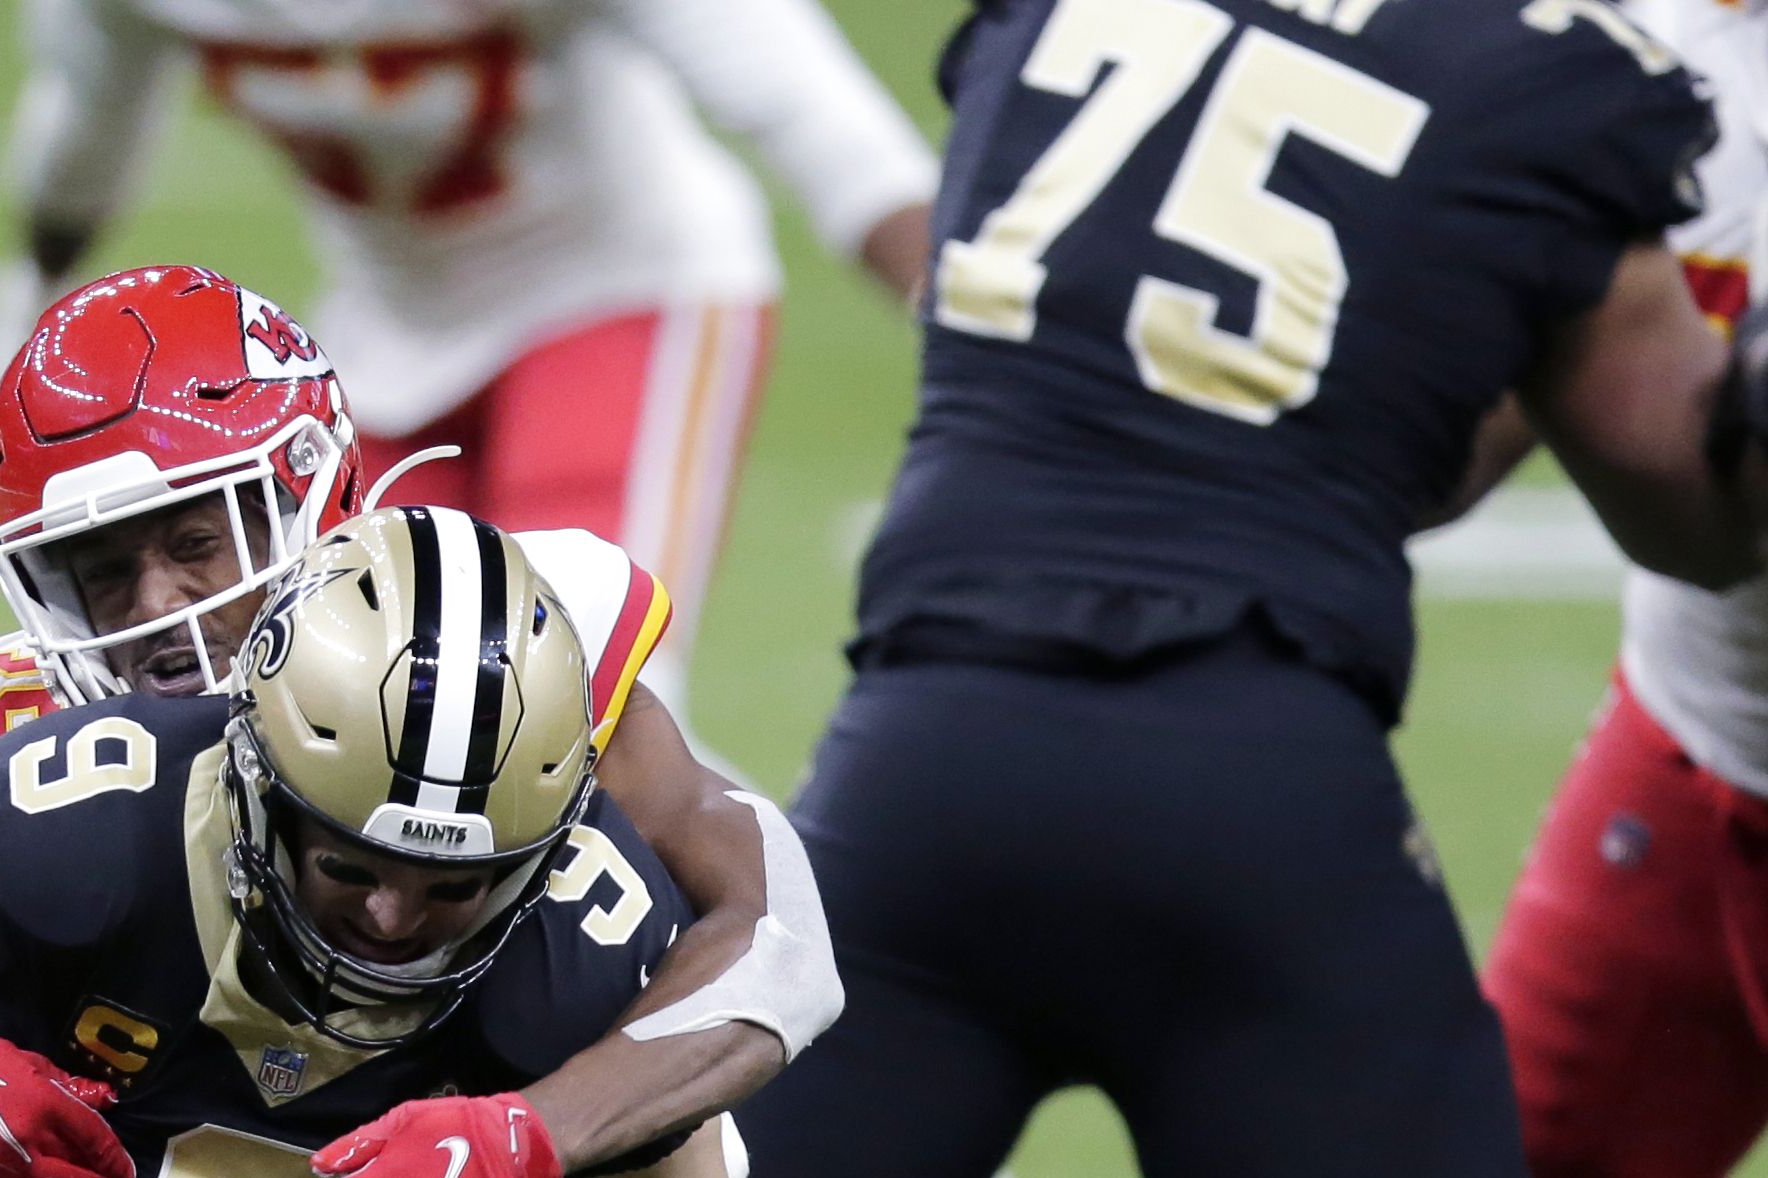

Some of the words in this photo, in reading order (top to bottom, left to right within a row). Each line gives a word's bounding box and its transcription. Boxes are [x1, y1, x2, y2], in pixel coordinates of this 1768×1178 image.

[938, 0, 1431, 425] 75
[245, 304, 318, 367] KC
[9, 716, 157, 814] 9
[401, 818, 468, 844] SAINTS
[74, 1004, 159, 1074] C
[262, 1064, 298, 1092] NFL
